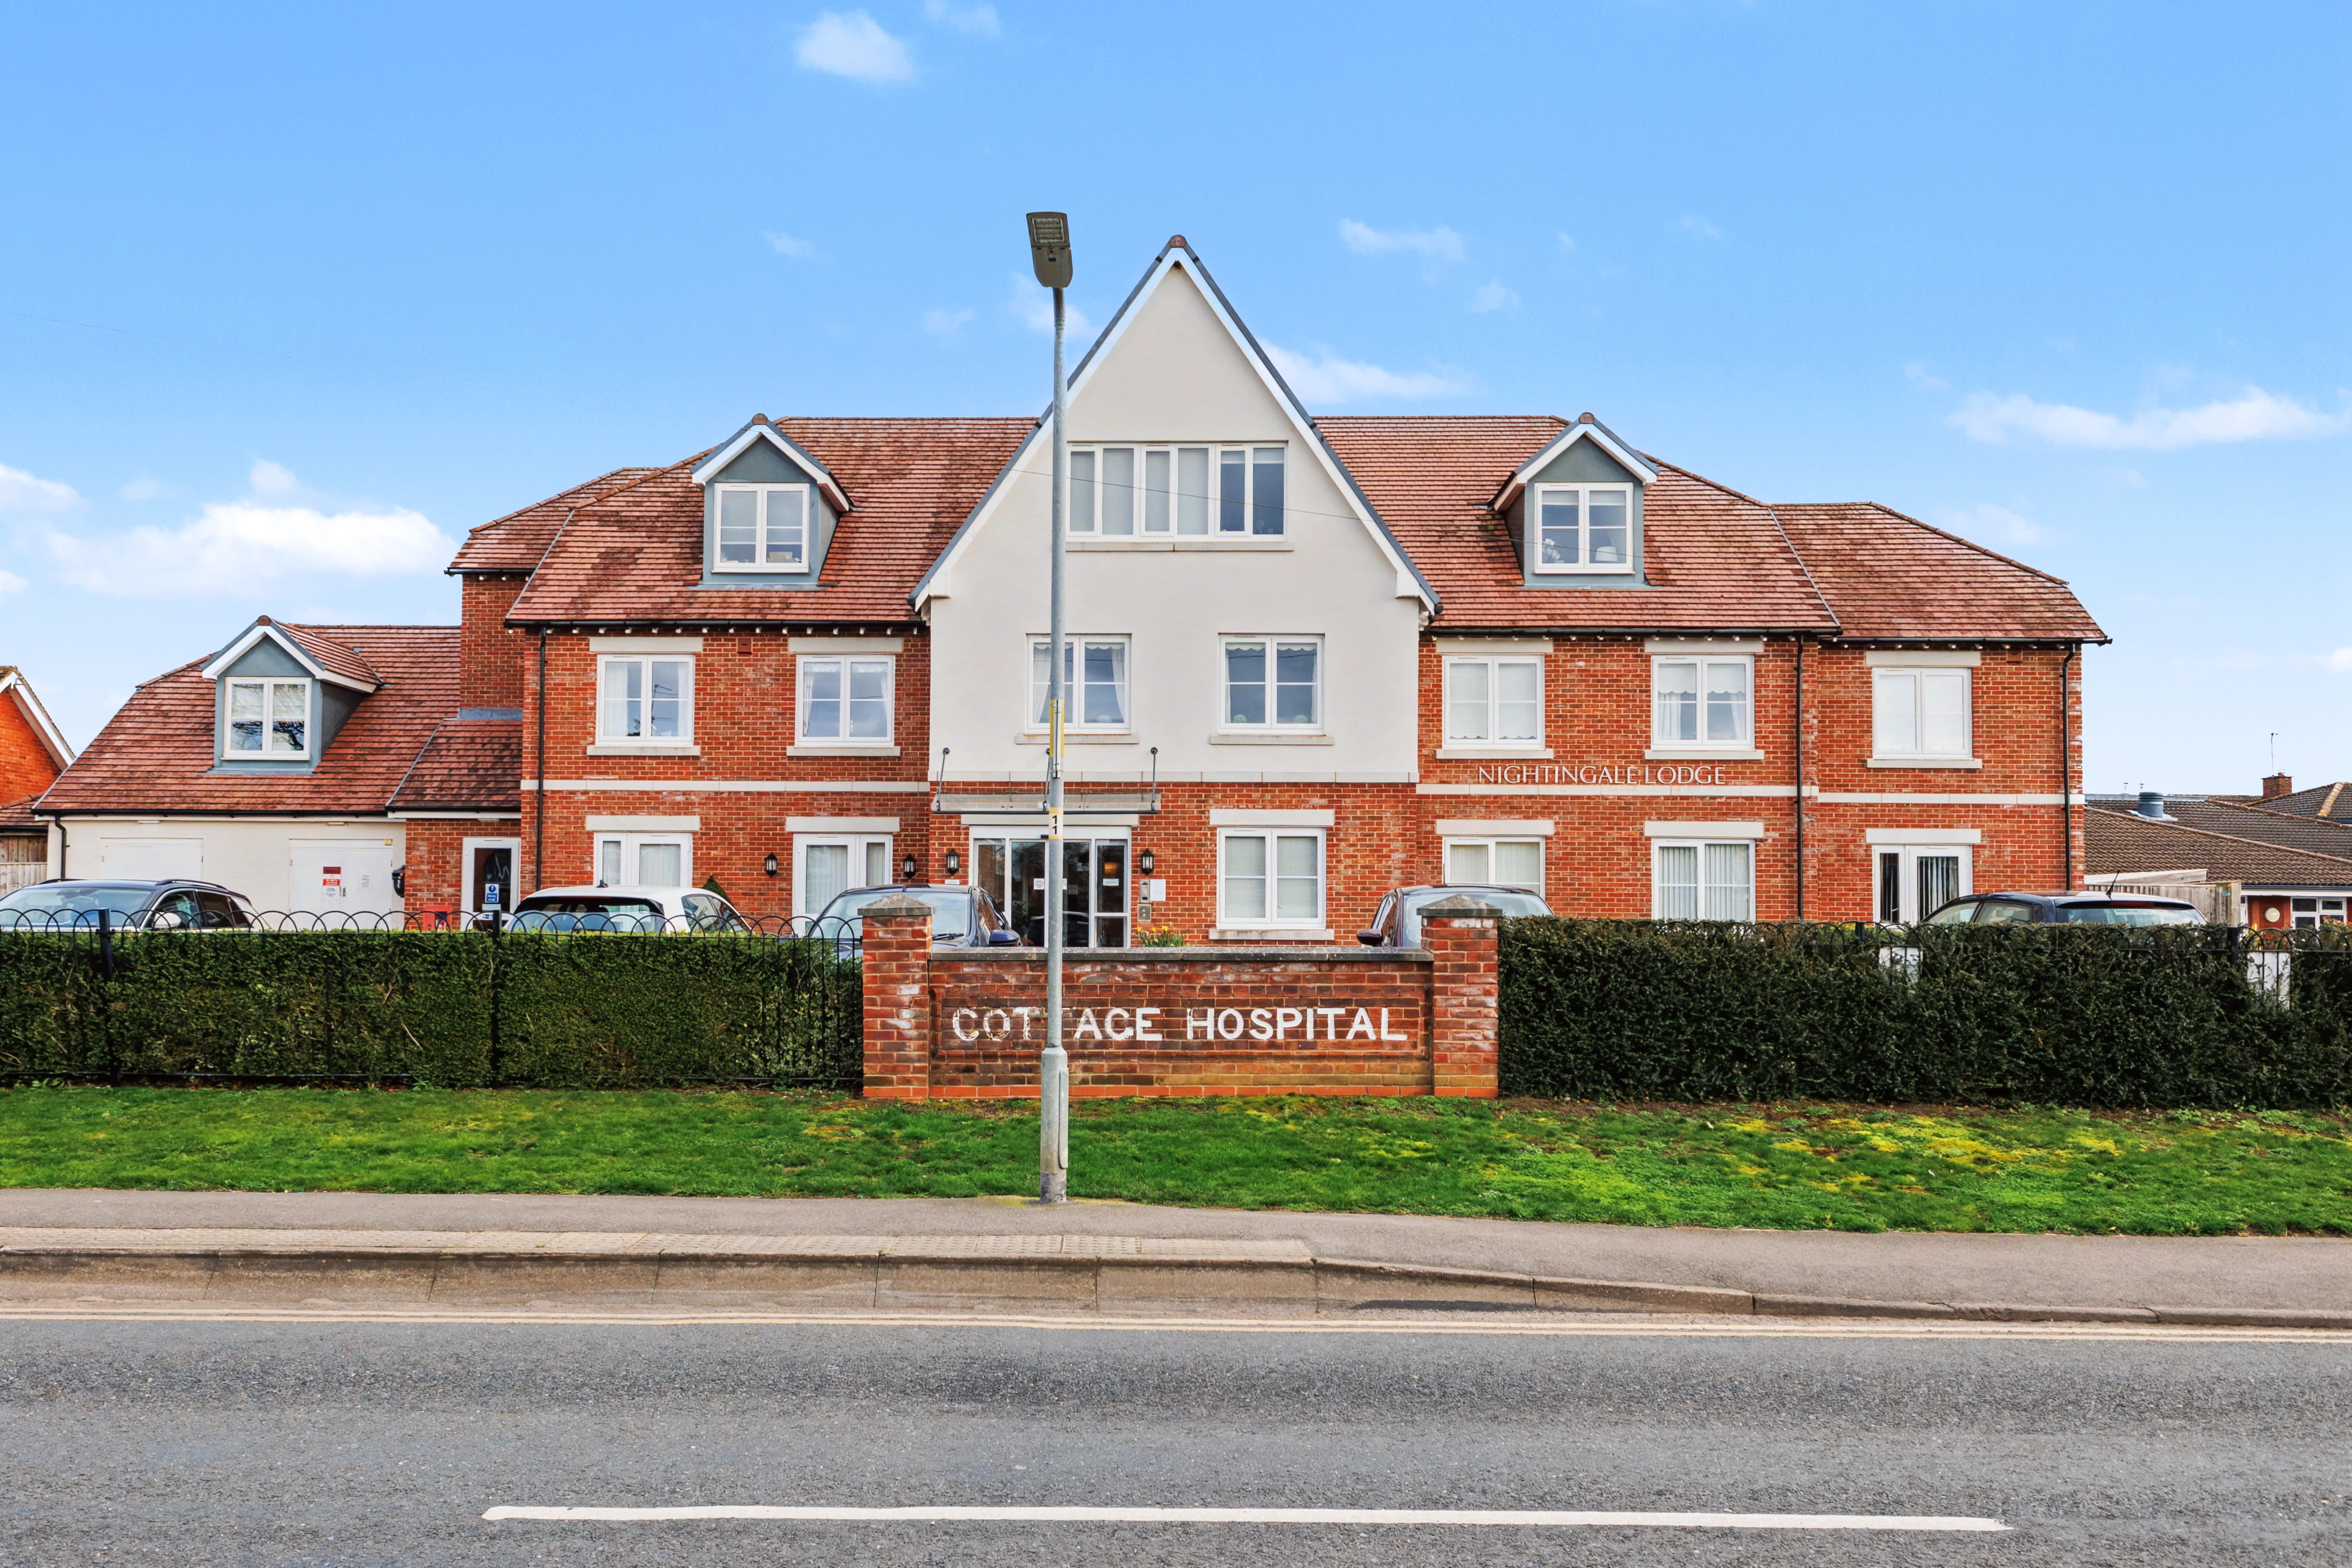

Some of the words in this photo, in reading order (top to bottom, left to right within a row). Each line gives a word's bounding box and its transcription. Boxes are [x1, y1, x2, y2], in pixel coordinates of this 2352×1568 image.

[1479, 765, 1638, 784] NIGHTINGALE
[1645, 765, 1725, 784] LODGE
[953, 1007, 1162, 1041] COTAGE
[1187, 1007, 1408, 1040] HOSPITAL
